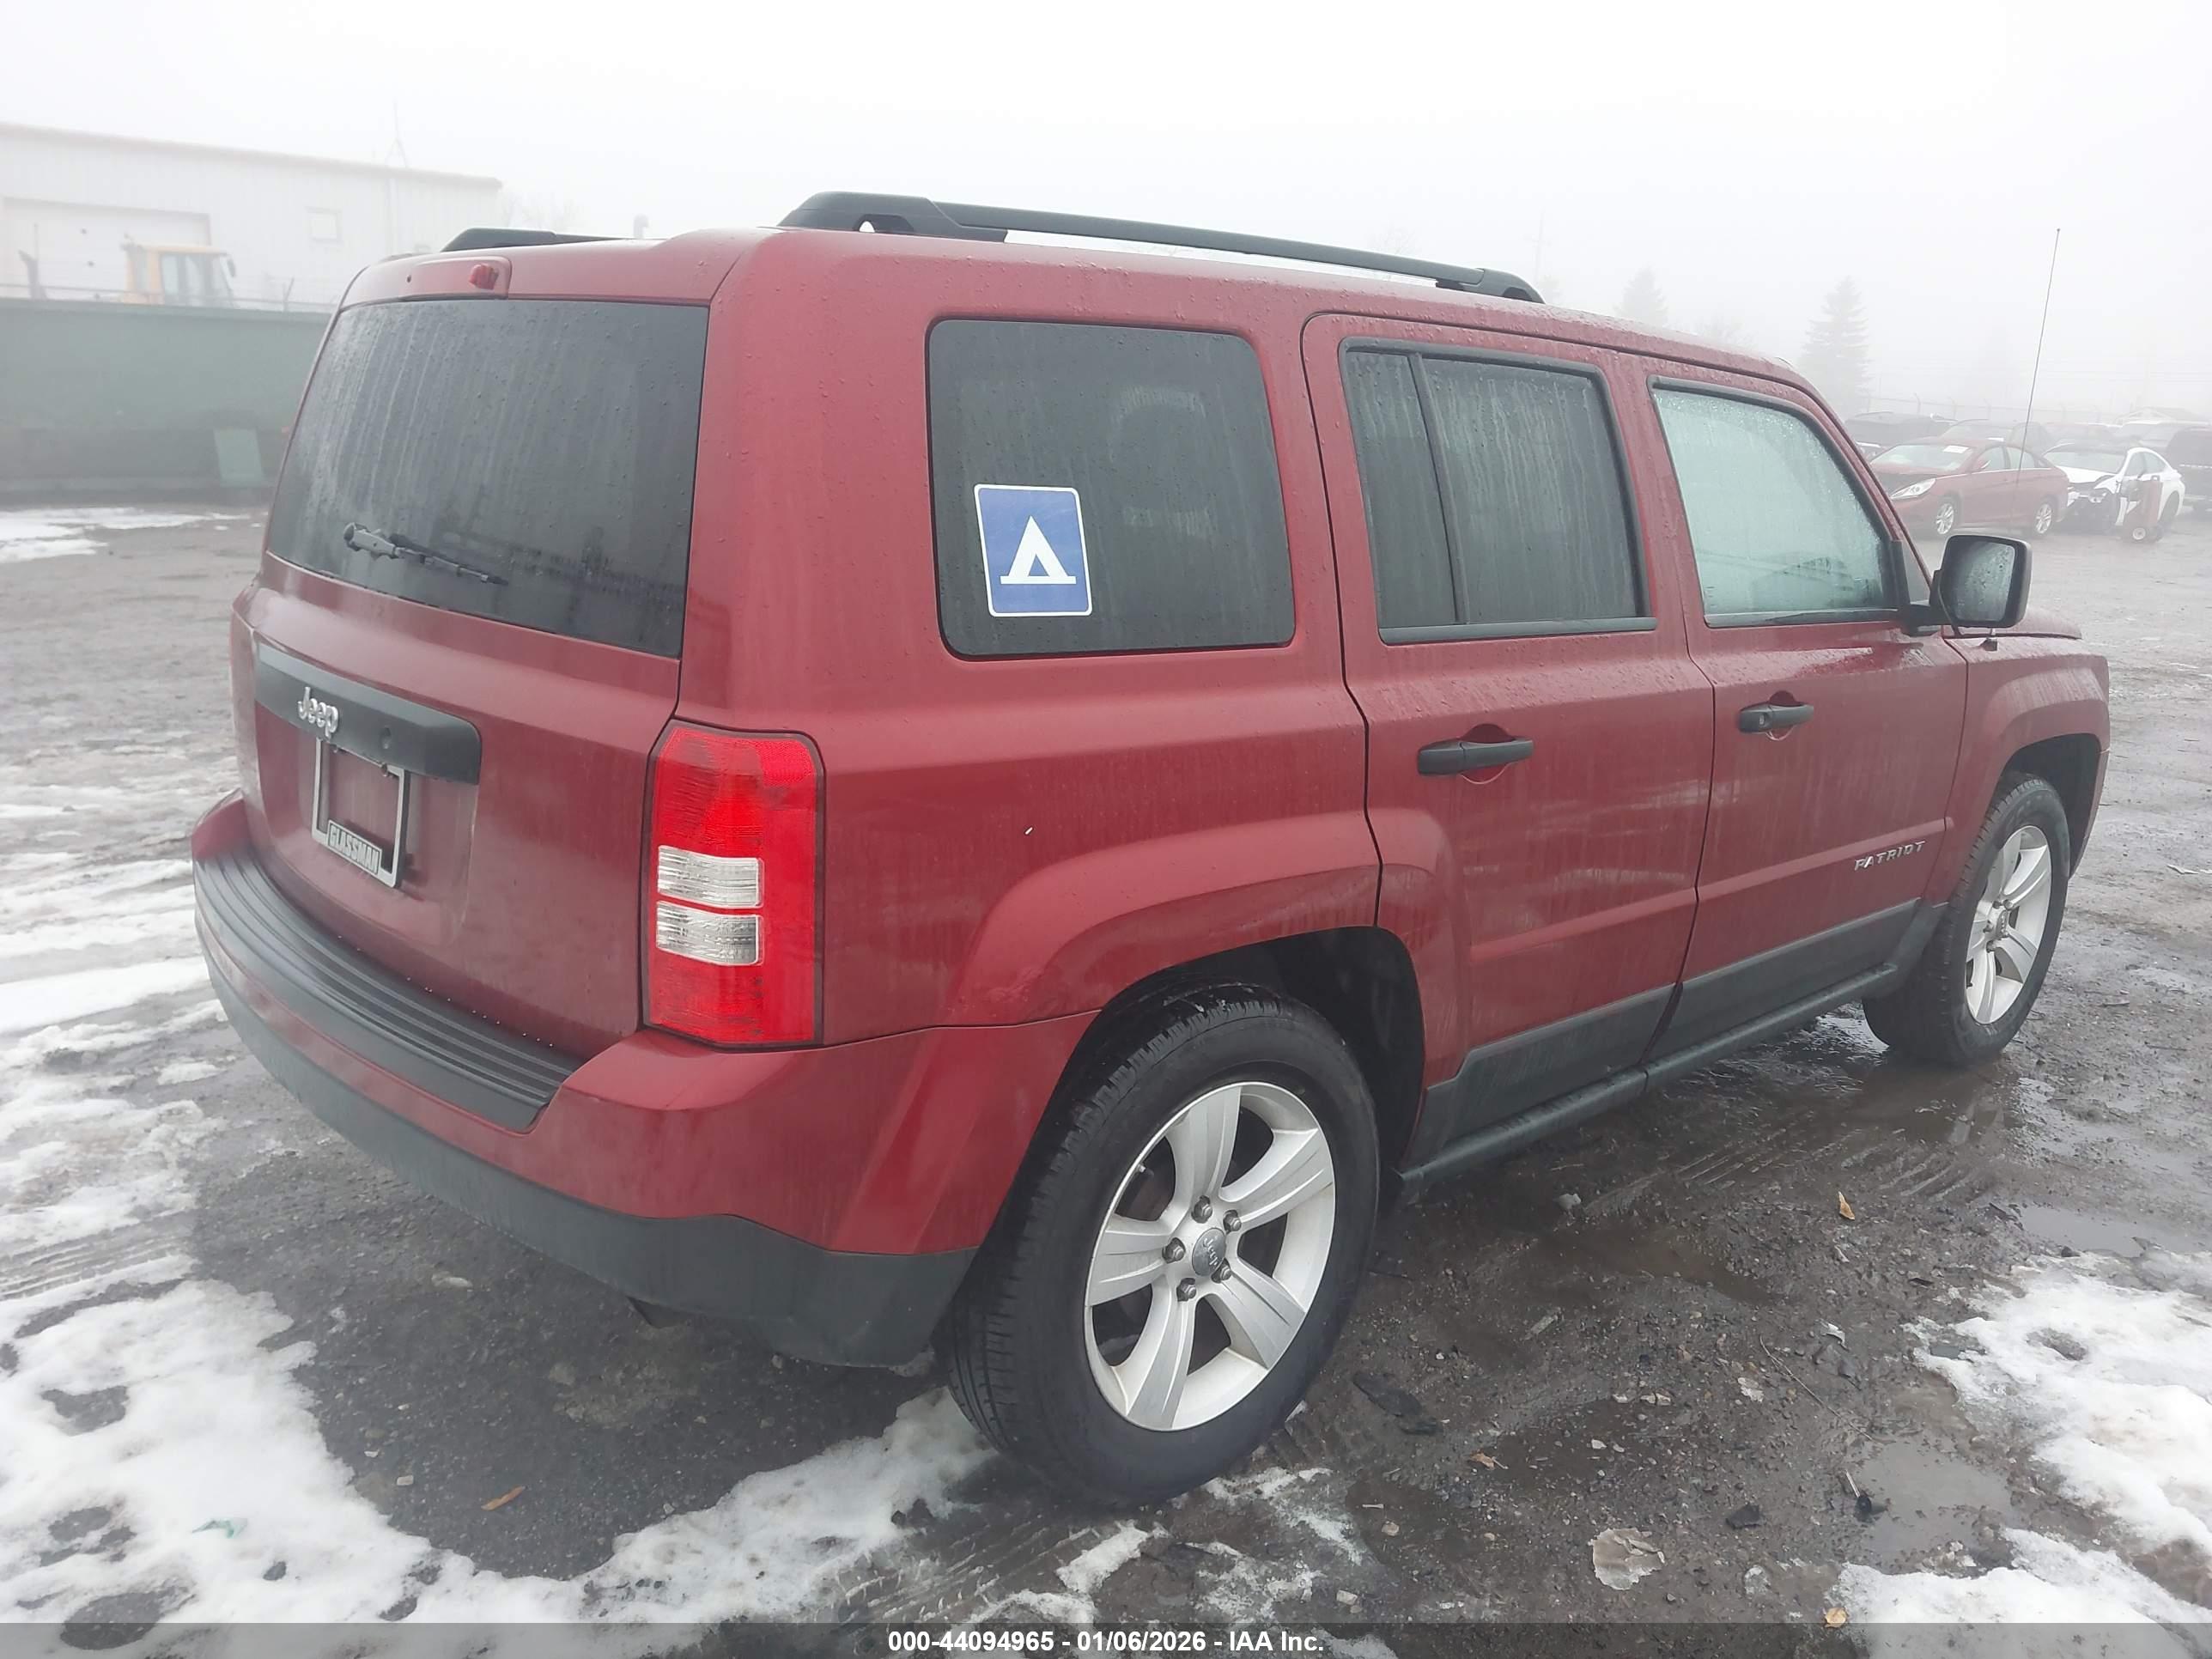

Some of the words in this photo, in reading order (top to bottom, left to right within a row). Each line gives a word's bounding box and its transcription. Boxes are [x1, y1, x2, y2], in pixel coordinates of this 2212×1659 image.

[297, 686, 338, 739] Jeep
[330, 824, 380, 874] GLASSMAN
[1854, 840, 1926, 871] PATRIOT
